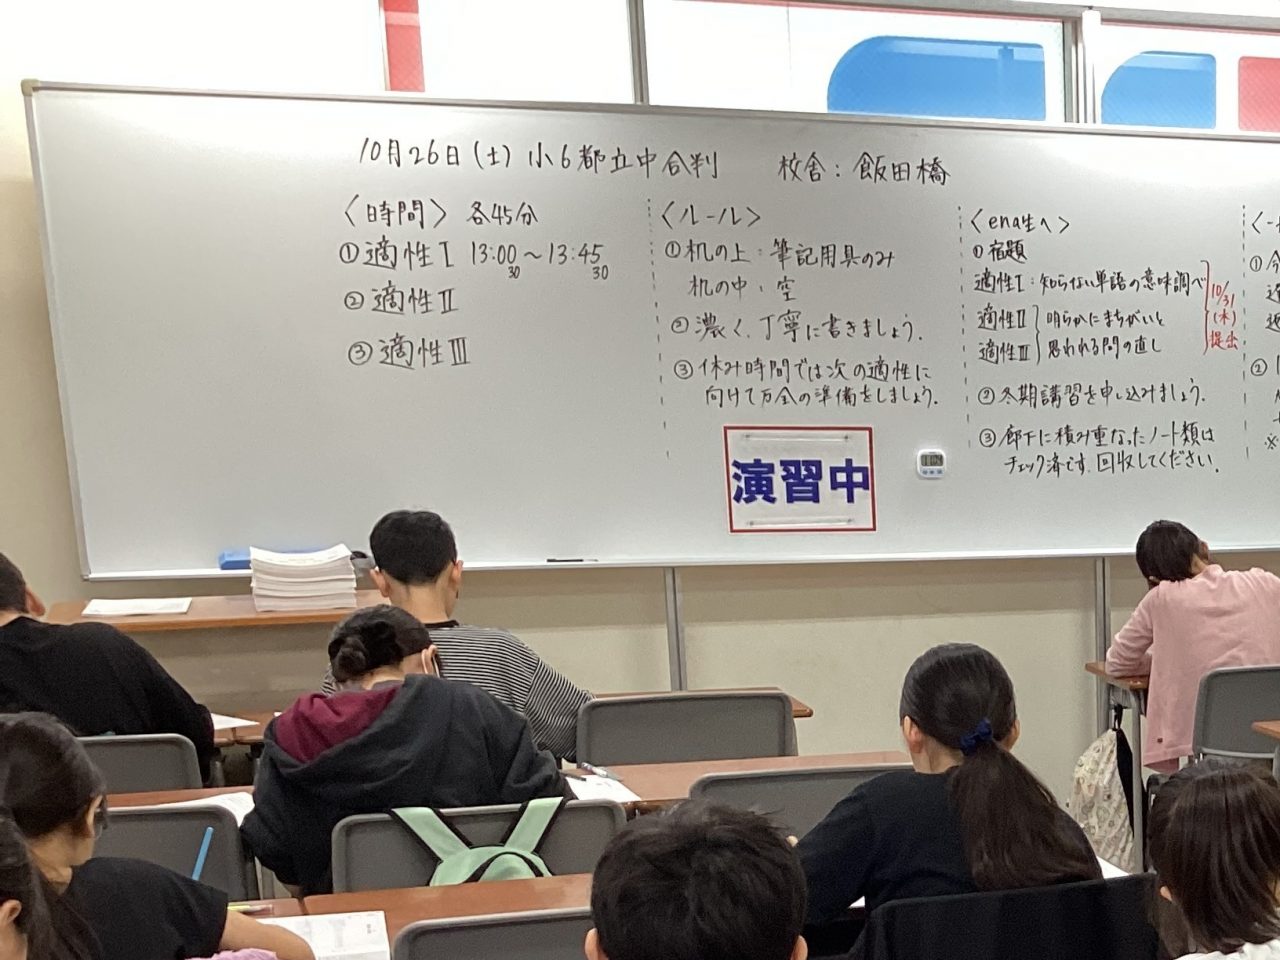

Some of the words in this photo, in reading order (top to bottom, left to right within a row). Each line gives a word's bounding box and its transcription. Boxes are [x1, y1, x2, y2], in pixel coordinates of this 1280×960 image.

[466, 201, 539, 226] 各45分
[508, 265, 521, 280] 30
[592, 265, 609, 280] 30
[1209, 330, 1239, 351] 提出
[732, 458, 870, 504] 演習中
